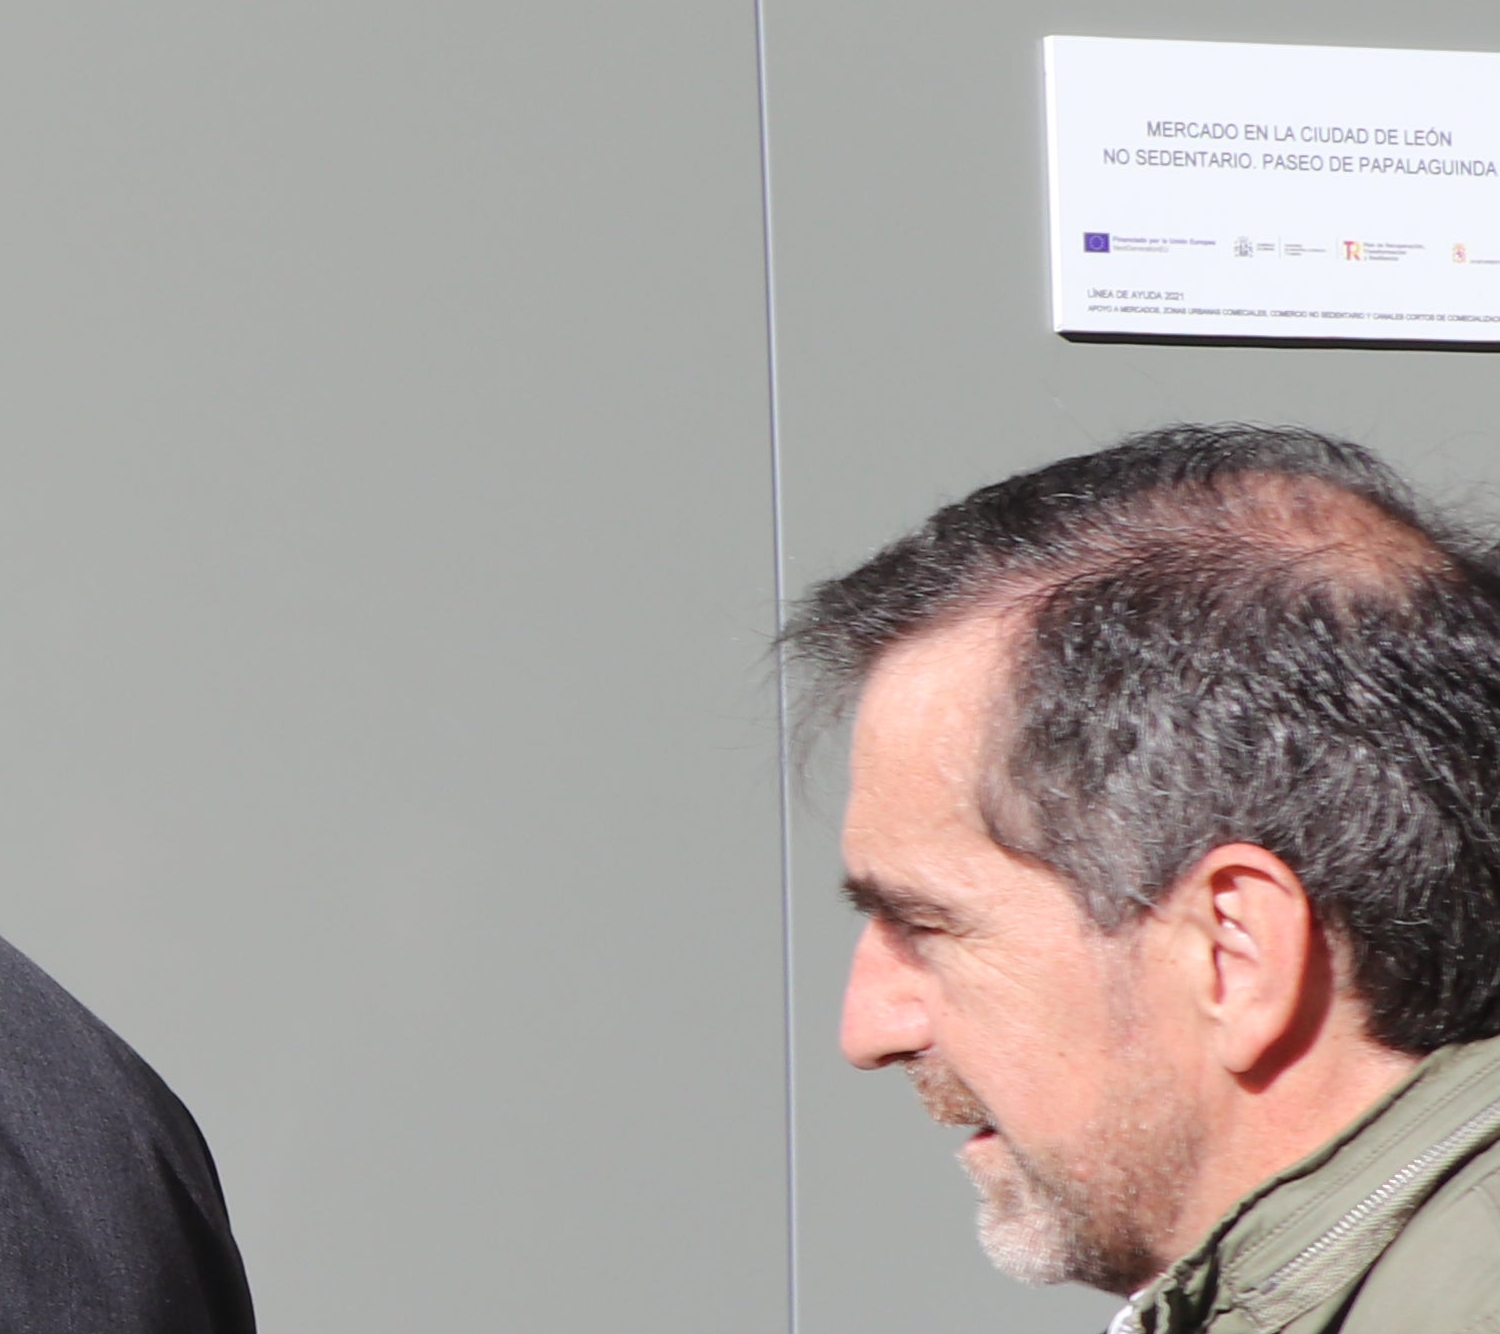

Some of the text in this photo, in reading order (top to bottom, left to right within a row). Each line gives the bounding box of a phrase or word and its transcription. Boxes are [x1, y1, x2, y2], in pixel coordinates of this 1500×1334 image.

[1146, 122, 1452, 147] MERCADO EN LA CIUDAD DE LEÓN
[1103, 148, 1497, 178] NO SEDENTARIO. PASEO DE PAPALAGUINDA
[1087, 287, 1114, 299] LÍNEA
[1115, 290, 1128, 299] DE
[1130, 290, 1162, 300] AYUDA
